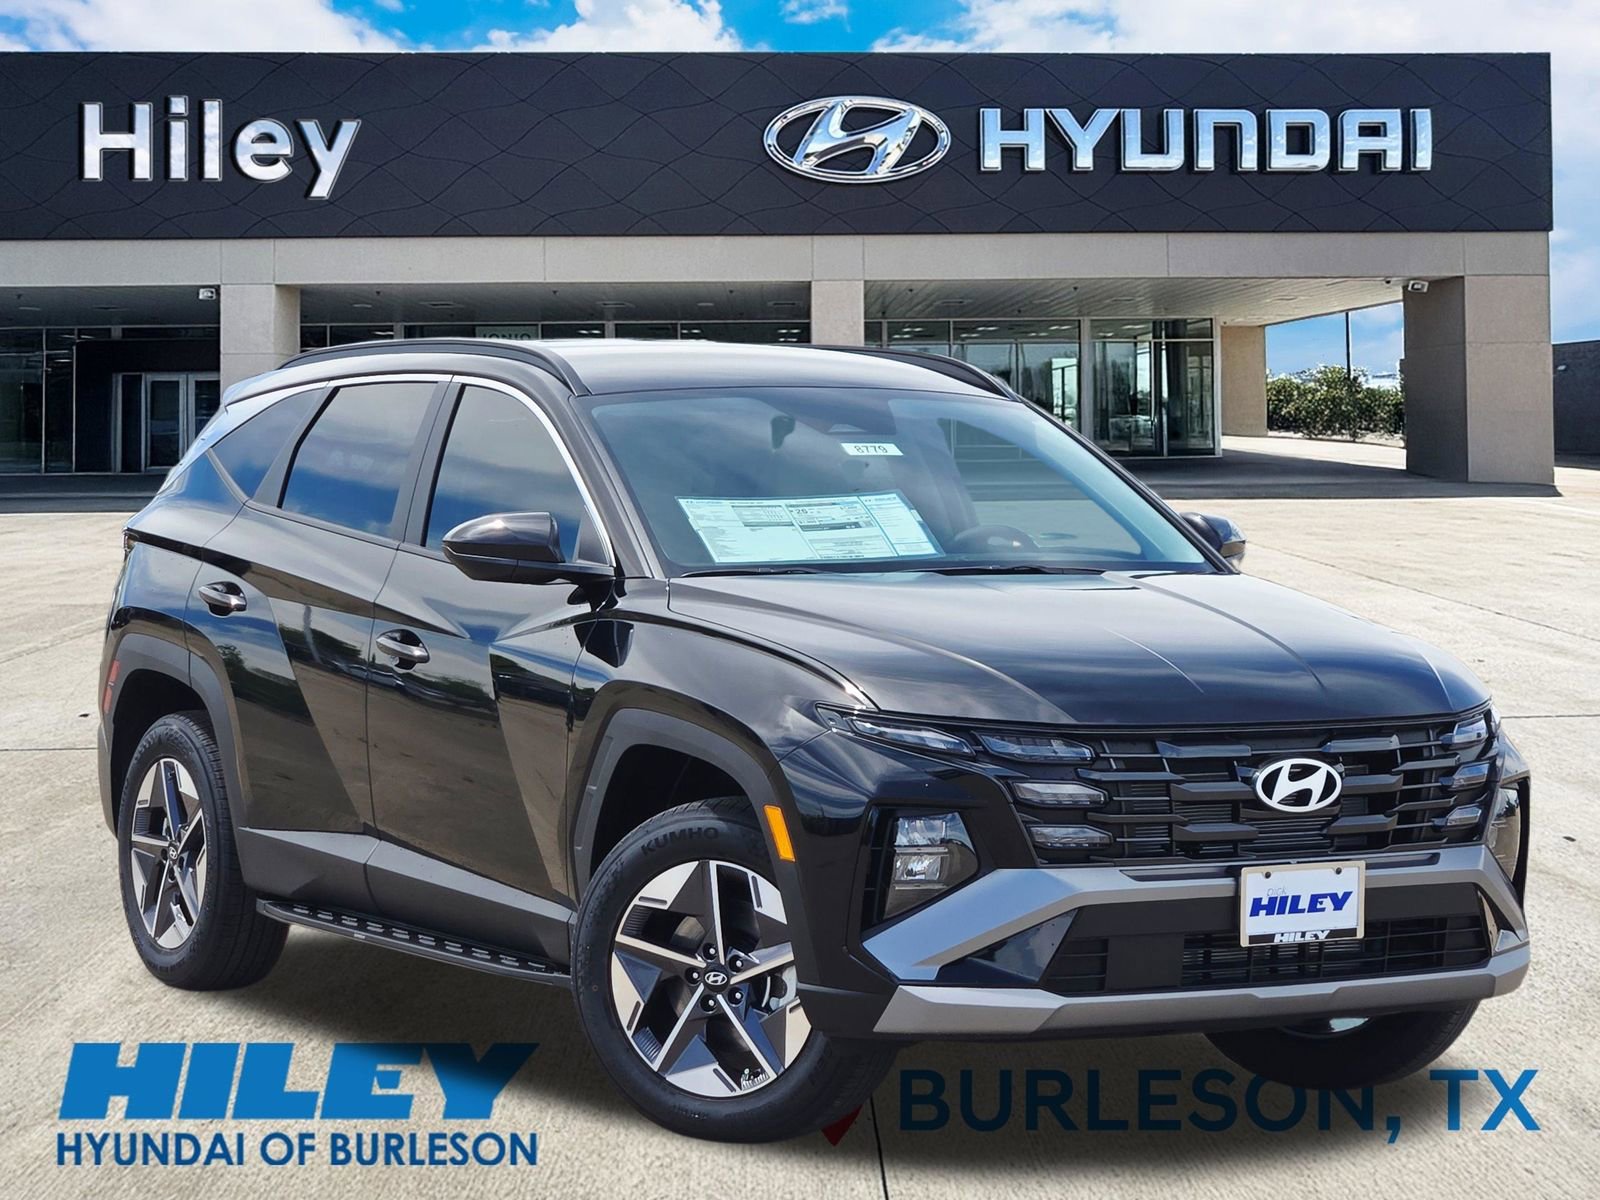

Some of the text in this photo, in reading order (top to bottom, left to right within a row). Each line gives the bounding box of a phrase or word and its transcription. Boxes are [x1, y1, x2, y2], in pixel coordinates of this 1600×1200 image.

[80, 95, 361, 199] Hiley
[979, 107, 1432, 172] HYUNDAI
[854, 445, 888, 453] 8779
[640, 826, 719, 857] KUMHO
[1249, 891, 1353, 917] HILEY
[1273, 929, 1330, 944] HILEY
